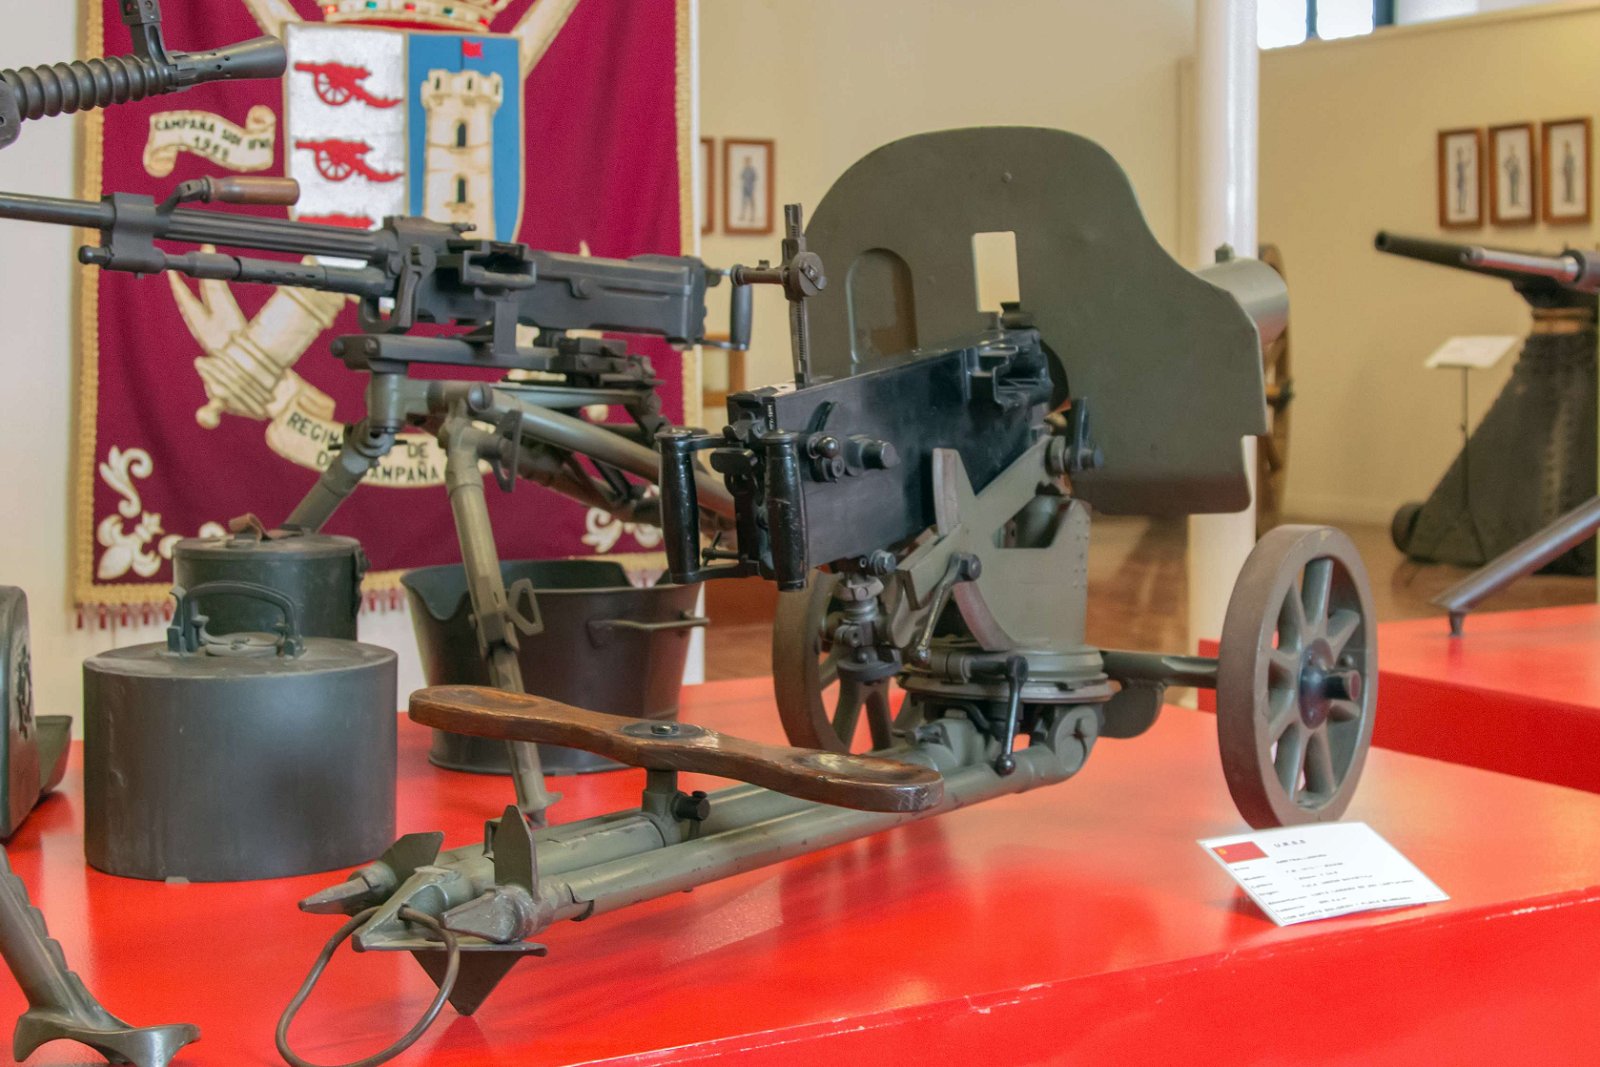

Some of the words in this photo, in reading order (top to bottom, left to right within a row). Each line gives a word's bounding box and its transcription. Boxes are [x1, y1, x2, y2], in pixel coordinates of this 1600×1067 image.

[287, 411, 341, 446] REGIM
[407, 442, 428, 458] DE
[370, 460, 440, 482] AMPAÑA
